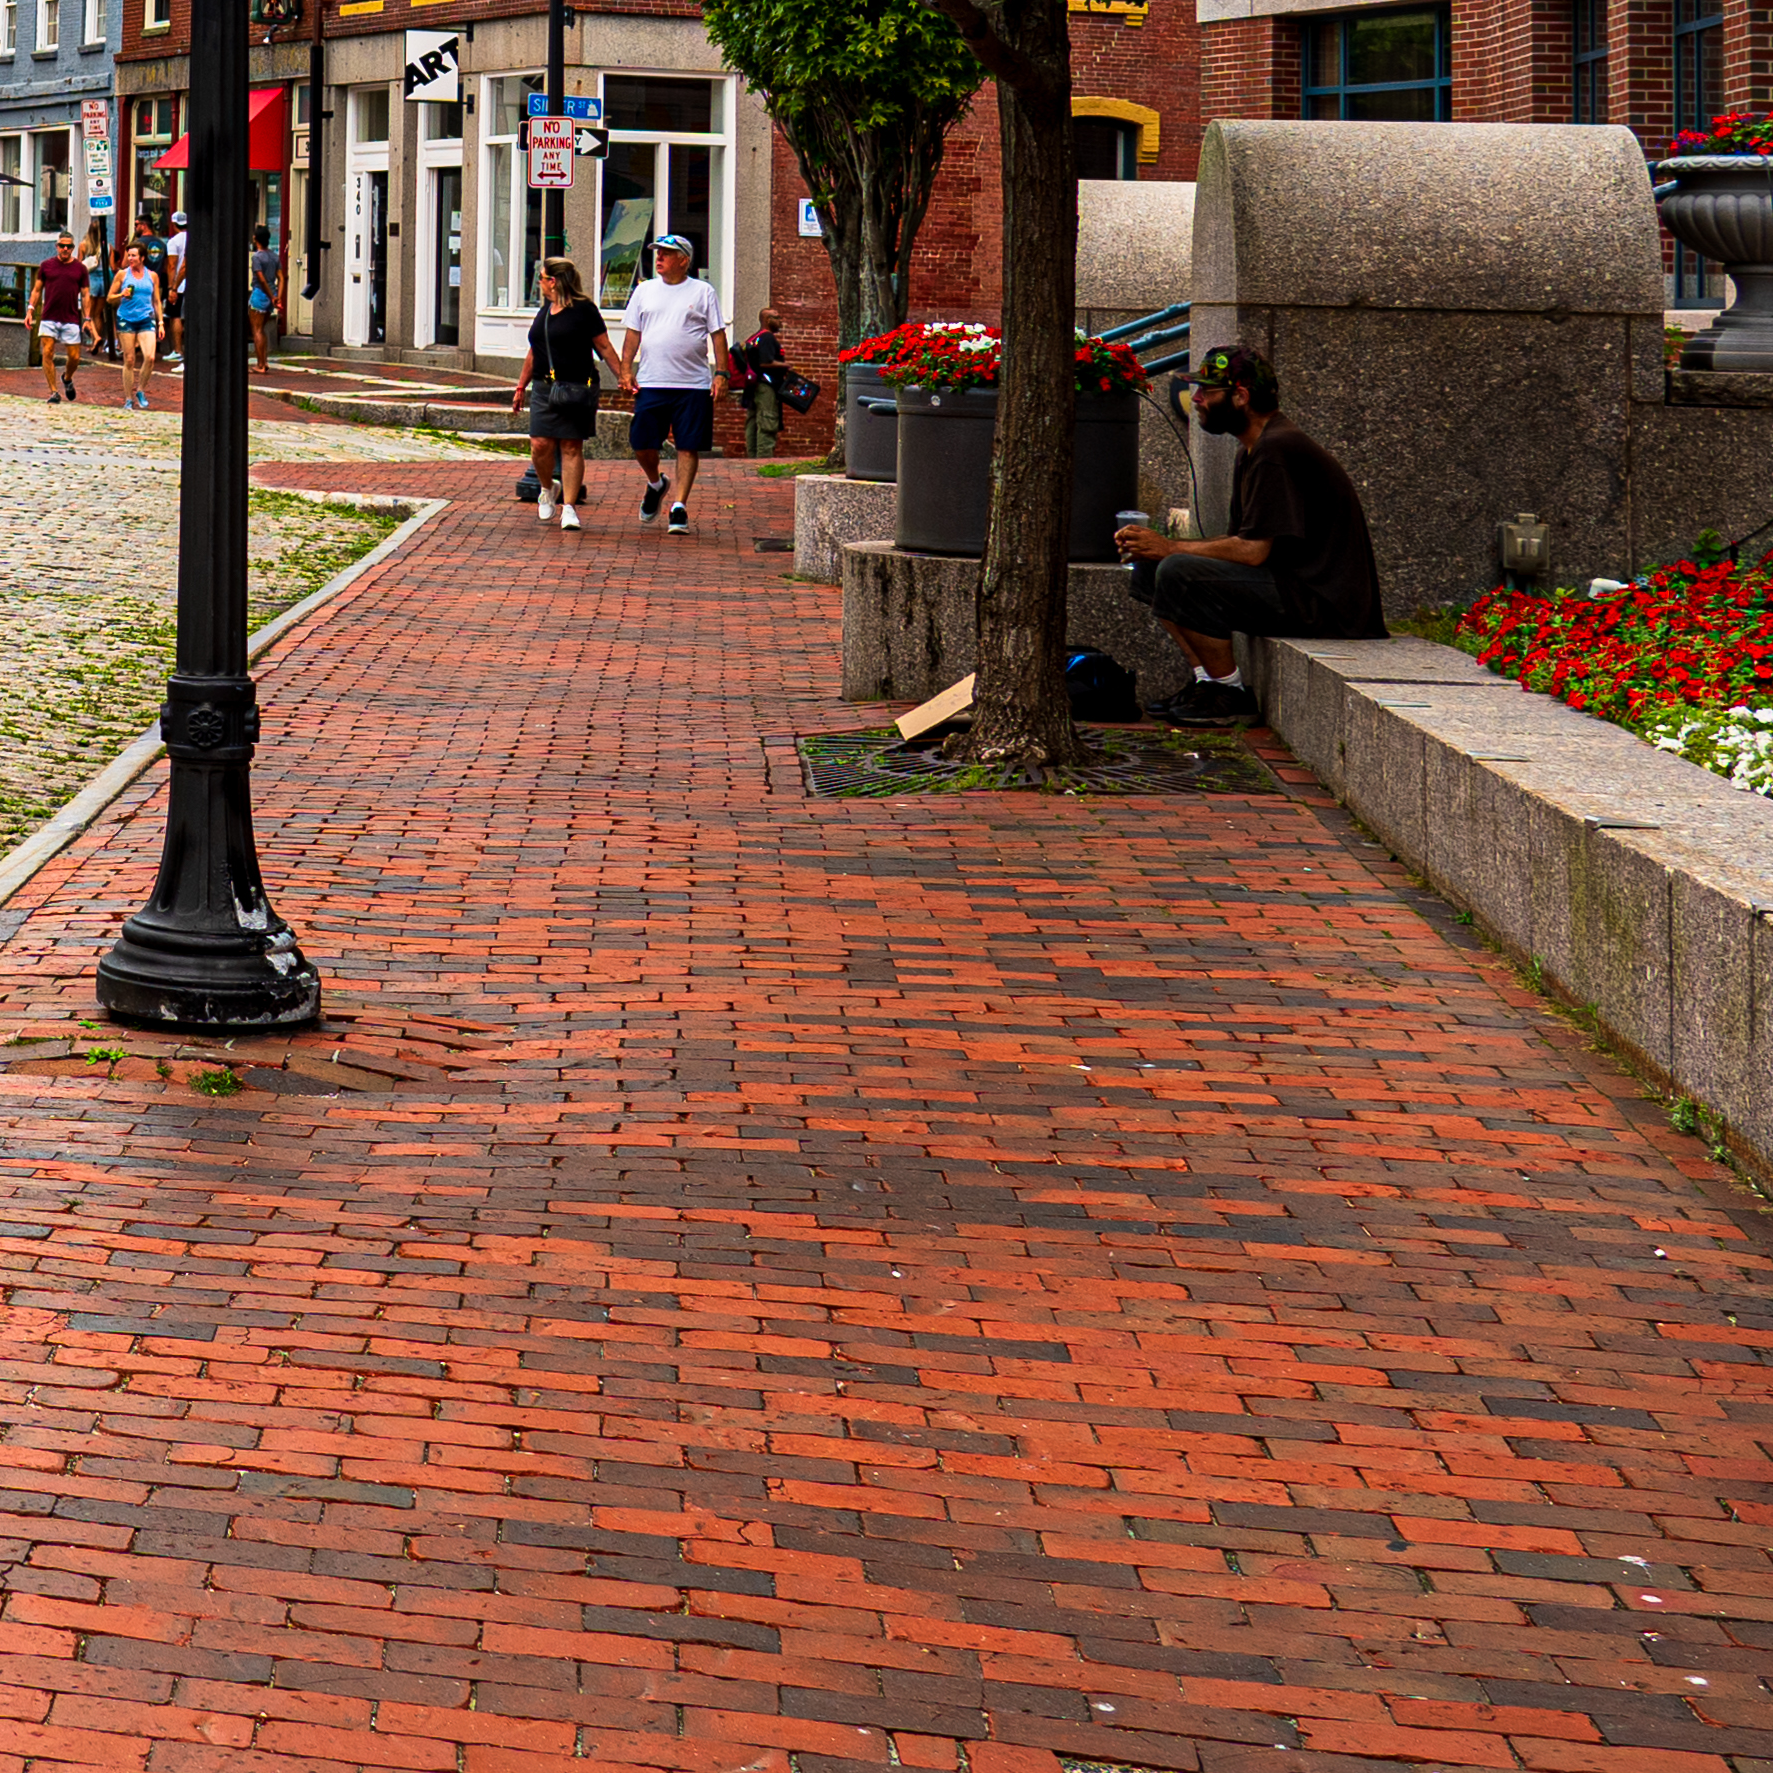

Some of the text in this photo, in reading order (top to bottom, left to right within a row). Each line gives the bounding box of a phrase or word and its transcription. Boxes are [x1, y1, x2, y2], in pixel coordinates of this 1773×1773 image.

[405, 36, 459, 98] ART
[533, 98, 575, 115] SIR
[543, 121, 561, 134] NO
[532, 137, 571, 149] PARKING
[543, 151, 561, 160] ANY
[541, 162, 562, 171] TIME
